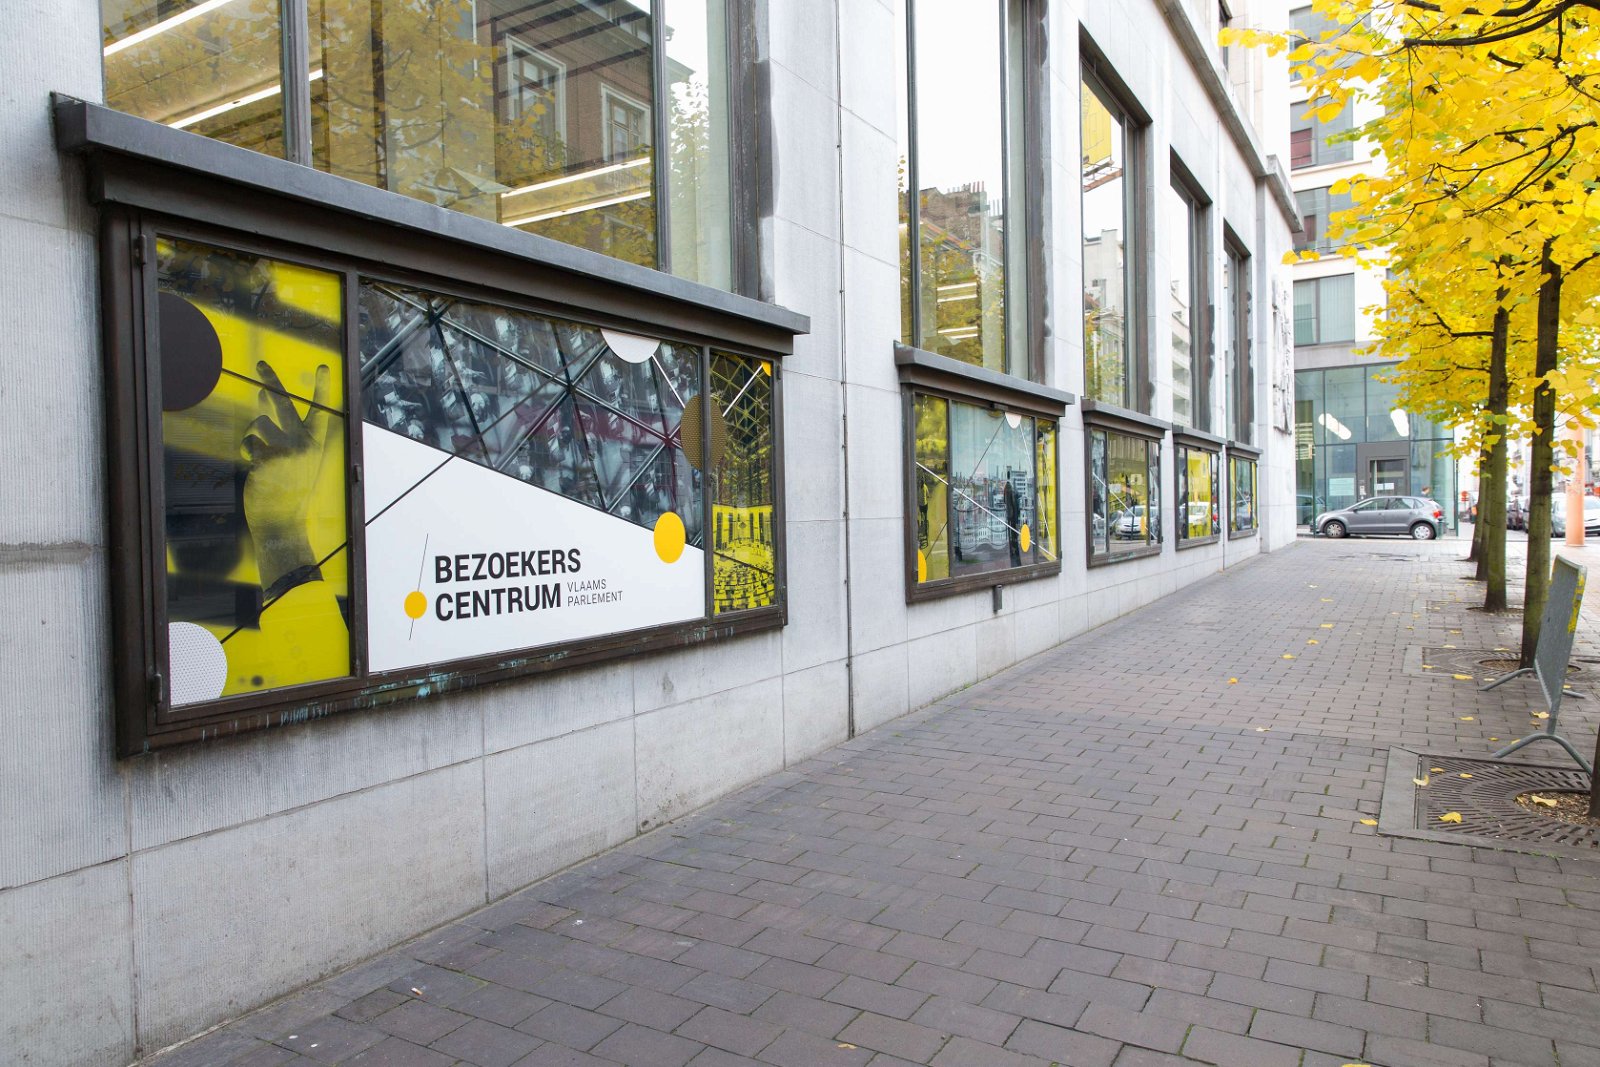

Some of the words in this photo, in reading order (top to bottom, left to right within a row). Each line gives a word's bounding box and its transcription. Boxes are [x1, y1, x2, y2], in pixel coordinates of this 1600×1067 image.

[435, 548, 582, 583] BEZOEKERS
[567, 579, 607, 593] VLAAMS
[567, 590, 623, 607] PARLEMENT
[436, 583, 562, 621] CENTRUM
